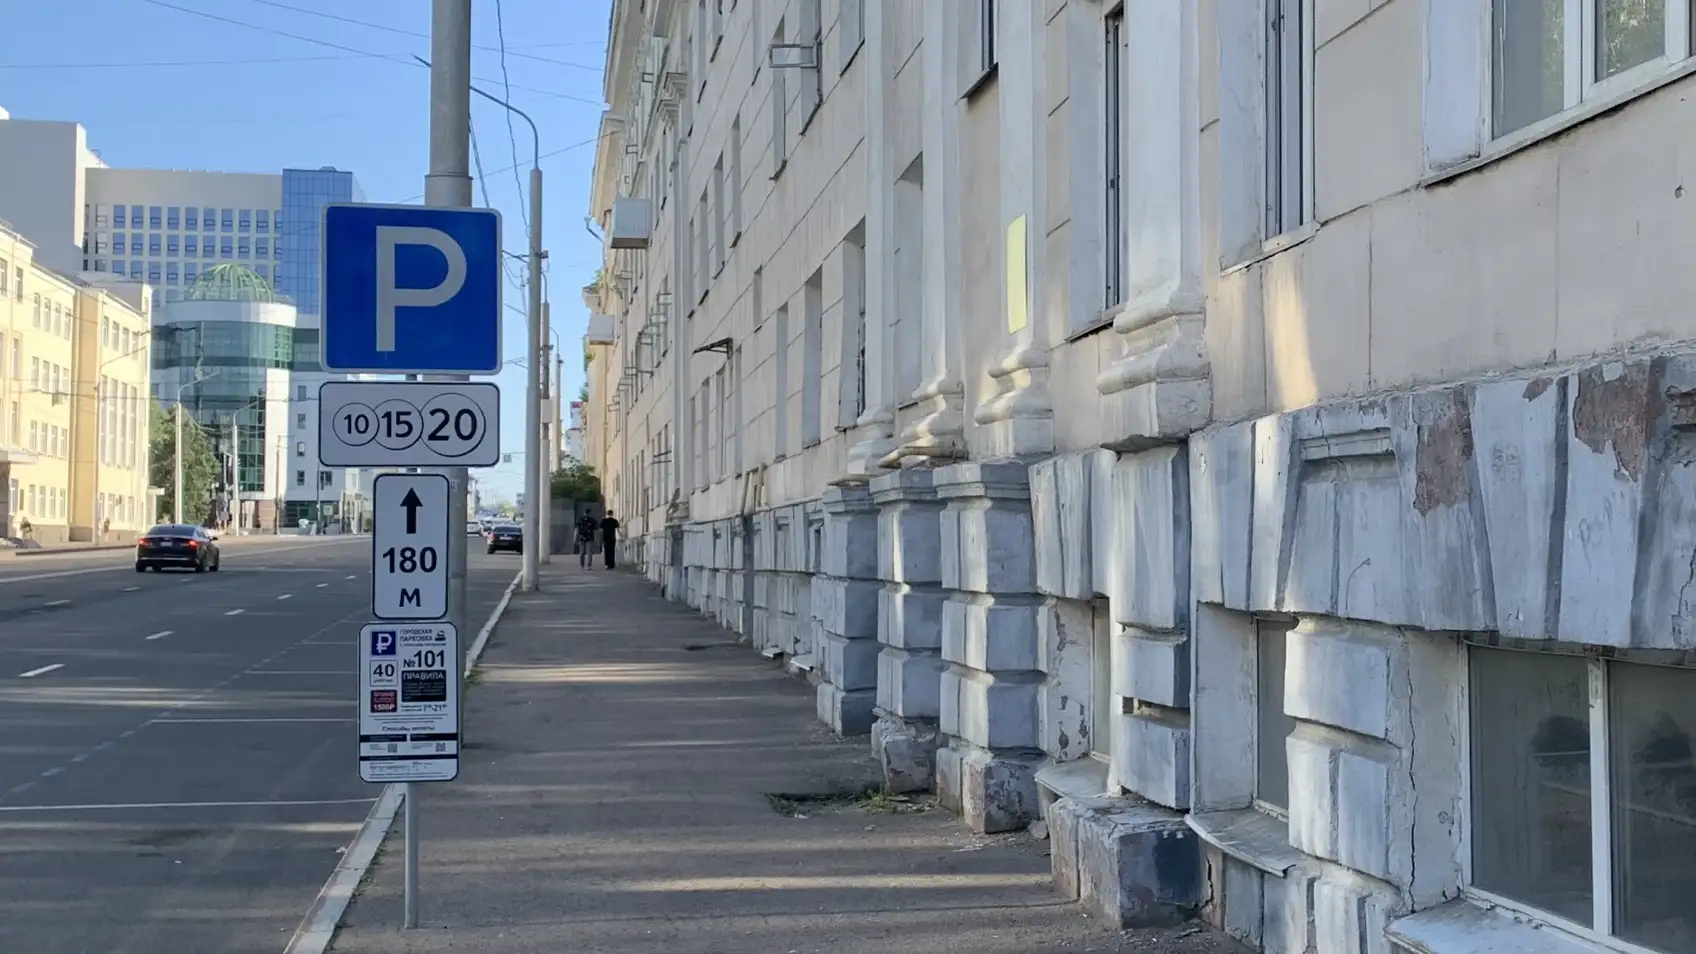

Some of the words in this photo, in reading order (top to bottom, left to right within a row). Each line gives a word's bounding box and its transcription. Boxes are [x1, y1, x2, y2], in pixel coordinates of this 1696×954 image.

[375, 225, 468, 352] P
[343, 413, 370, 435] 10
[381, 411, 414, 438] 15
[427, 407, 478, 442] 20
[382, 546, 436, 574] 180
[373, 663, 394, 677] 40
[403, 671, 444, 680] ПРАВИЛА
